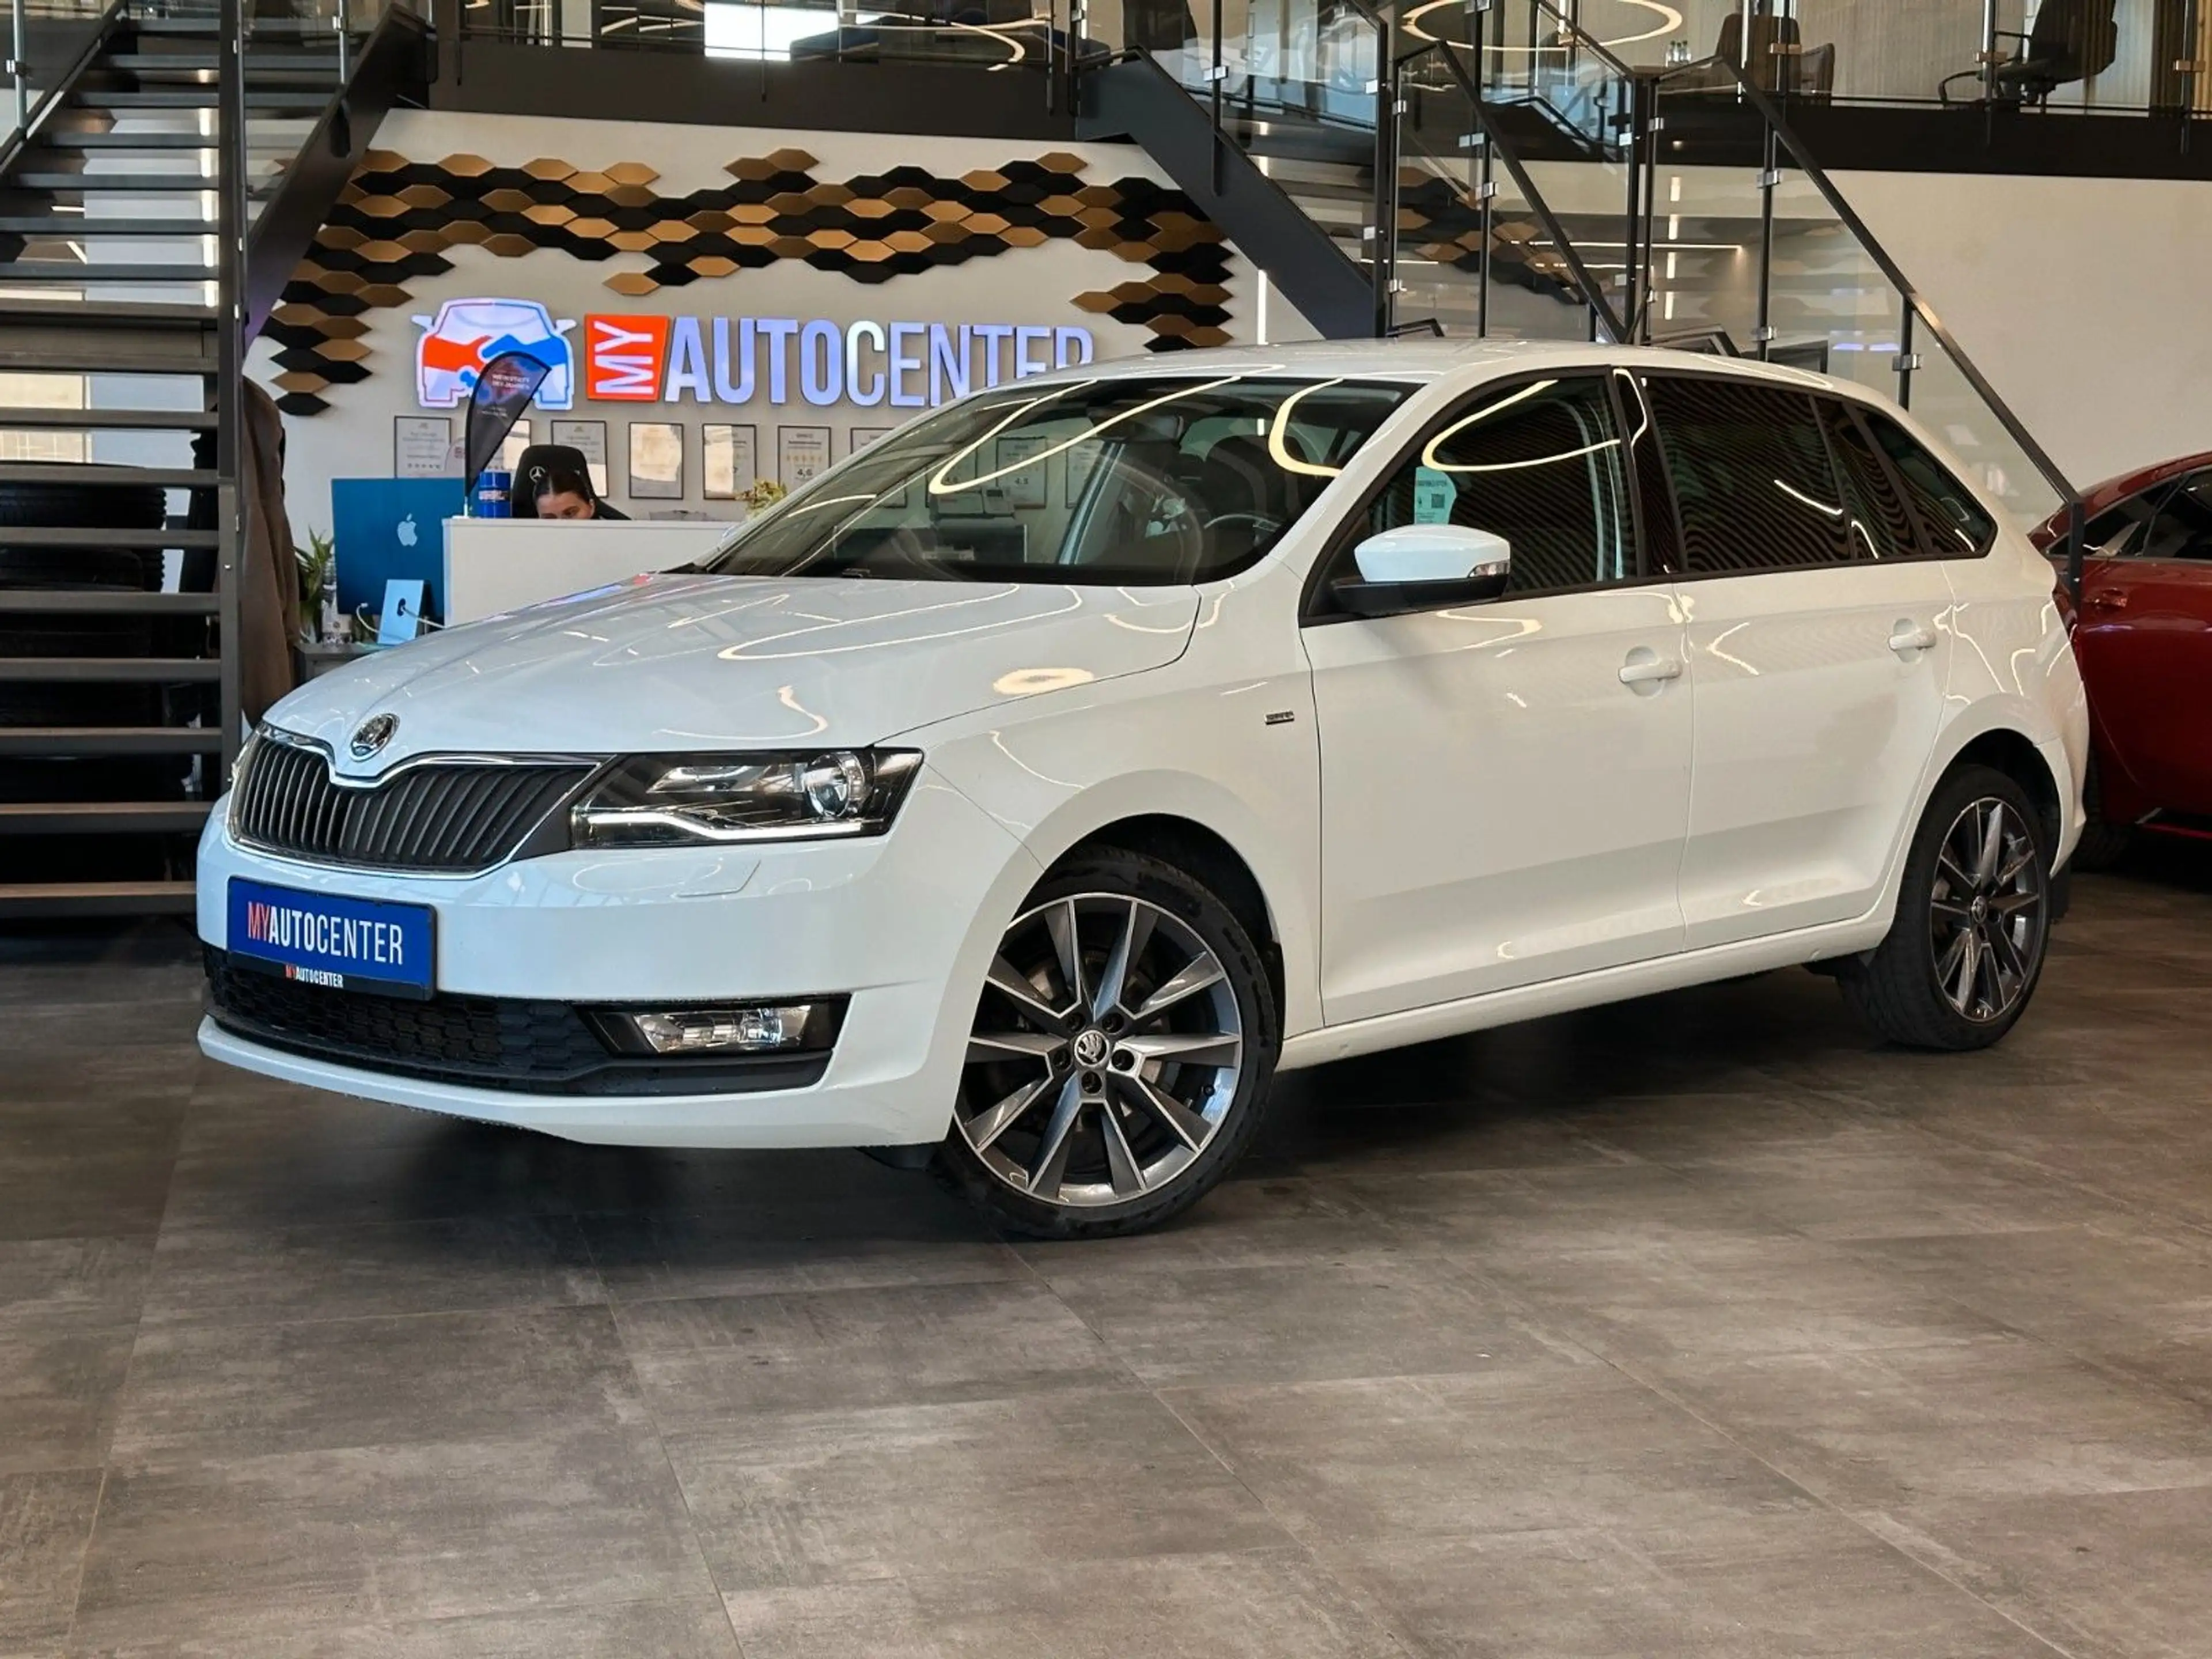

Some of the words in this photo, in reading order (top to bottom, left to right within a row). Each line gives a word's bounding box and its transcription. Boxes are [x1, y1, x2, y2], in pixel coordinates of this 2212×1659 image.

[594, 320, 654, 394] MY
[248, 901, 403, 965] MYAUTOCENTER
[286, 964, 344, 988] MYAUTOCENTER
